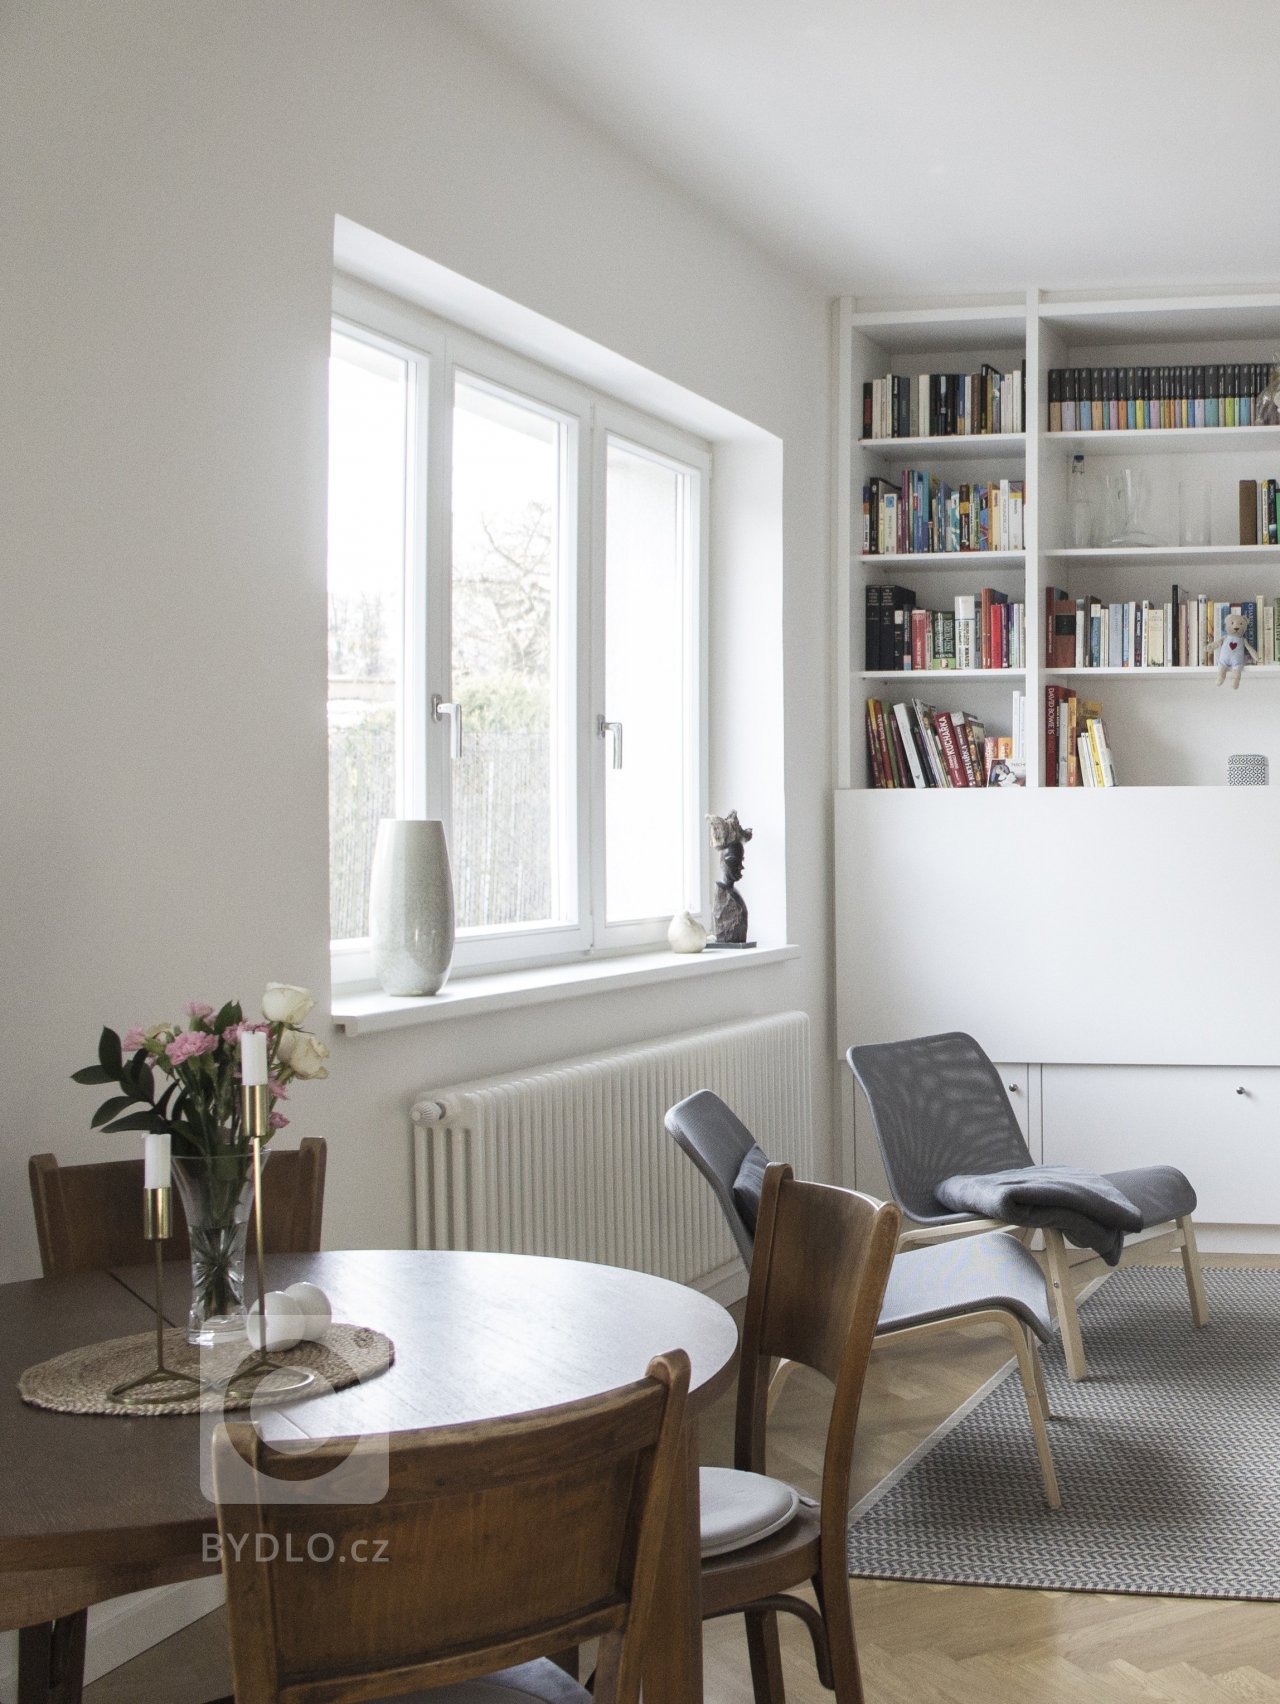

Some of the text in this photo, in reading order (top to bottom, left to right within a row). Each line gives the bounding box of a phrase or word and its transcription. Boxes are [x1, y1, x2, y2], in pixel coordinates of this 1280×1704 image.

[1047, 687, 1055, 707] DAVID
[1047, 708, 1055, 729] BOWIE
[938, 716, 955, 757] KUCHAŘKA
